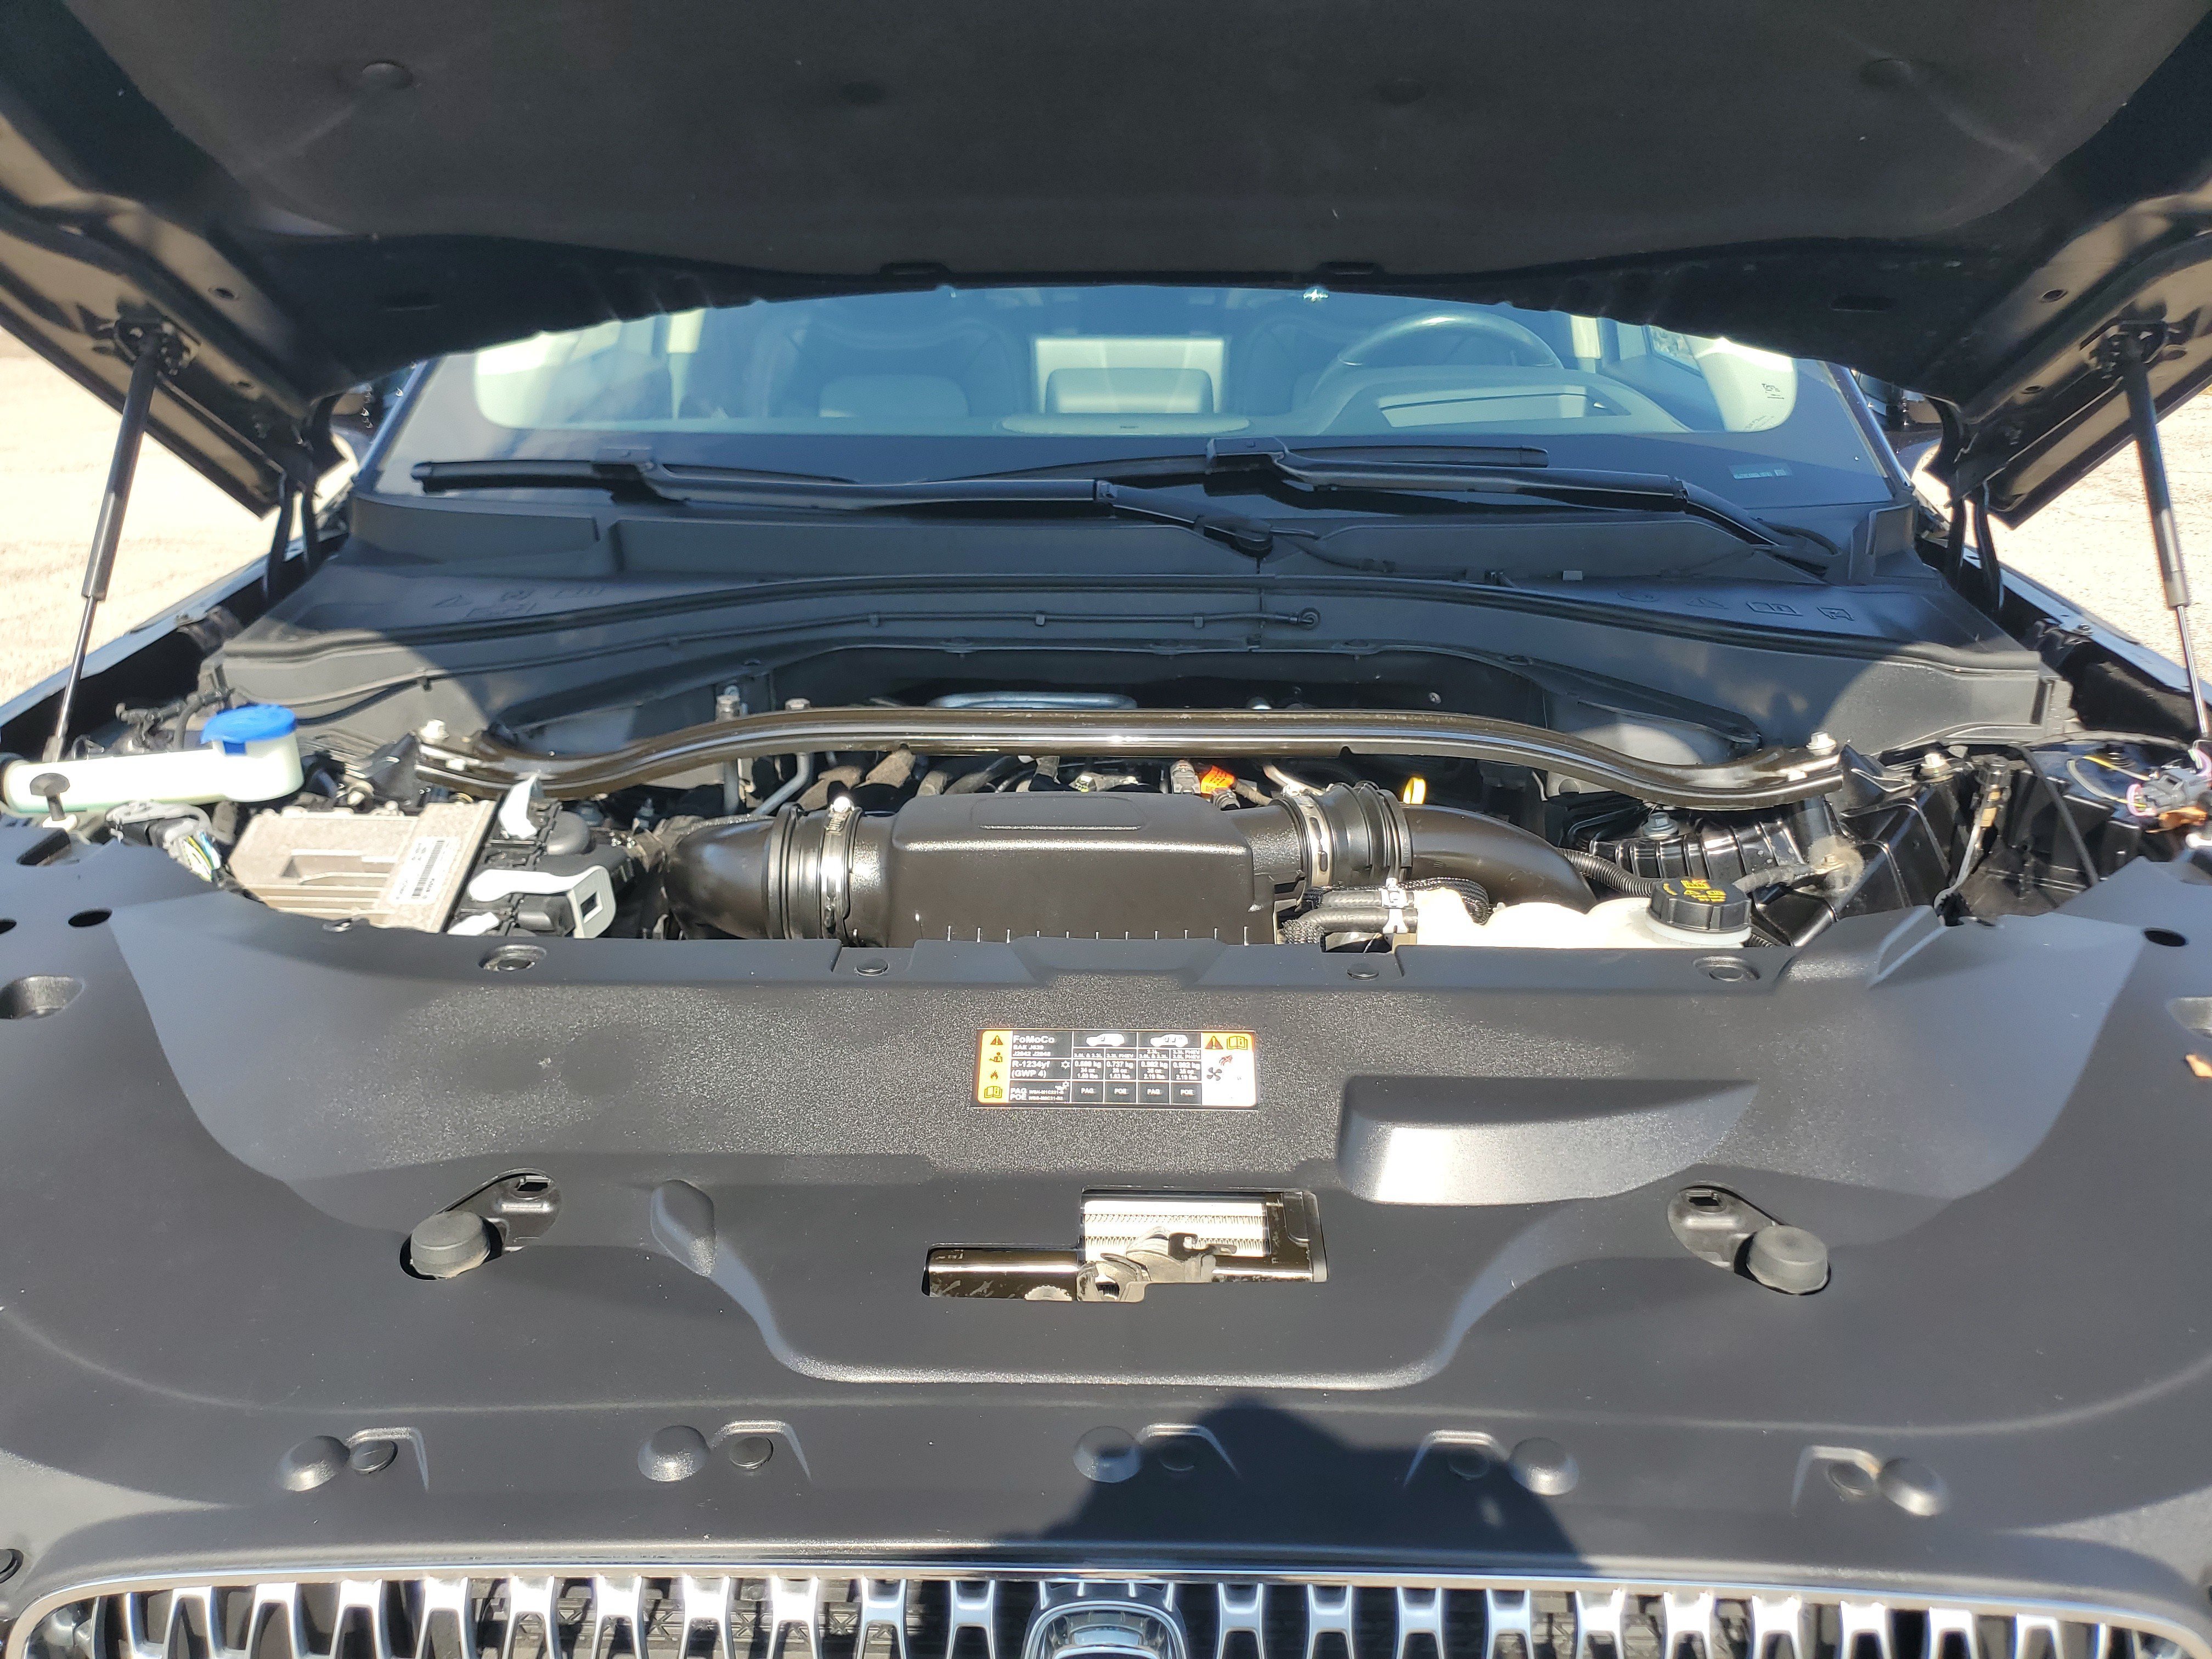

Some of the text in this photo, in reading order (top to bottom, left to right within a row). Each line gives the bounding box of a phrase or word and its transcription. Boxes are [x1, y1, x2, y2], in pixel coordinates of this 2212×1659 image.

[1013, 1035, 1055, 1043] FoMoCo
[1012, 1060, 1051, 1069] R-1234yf
[1093, 1060, 1102, 1069] kg
[1011, 1069, 1047, 1079] (GWP 4)
